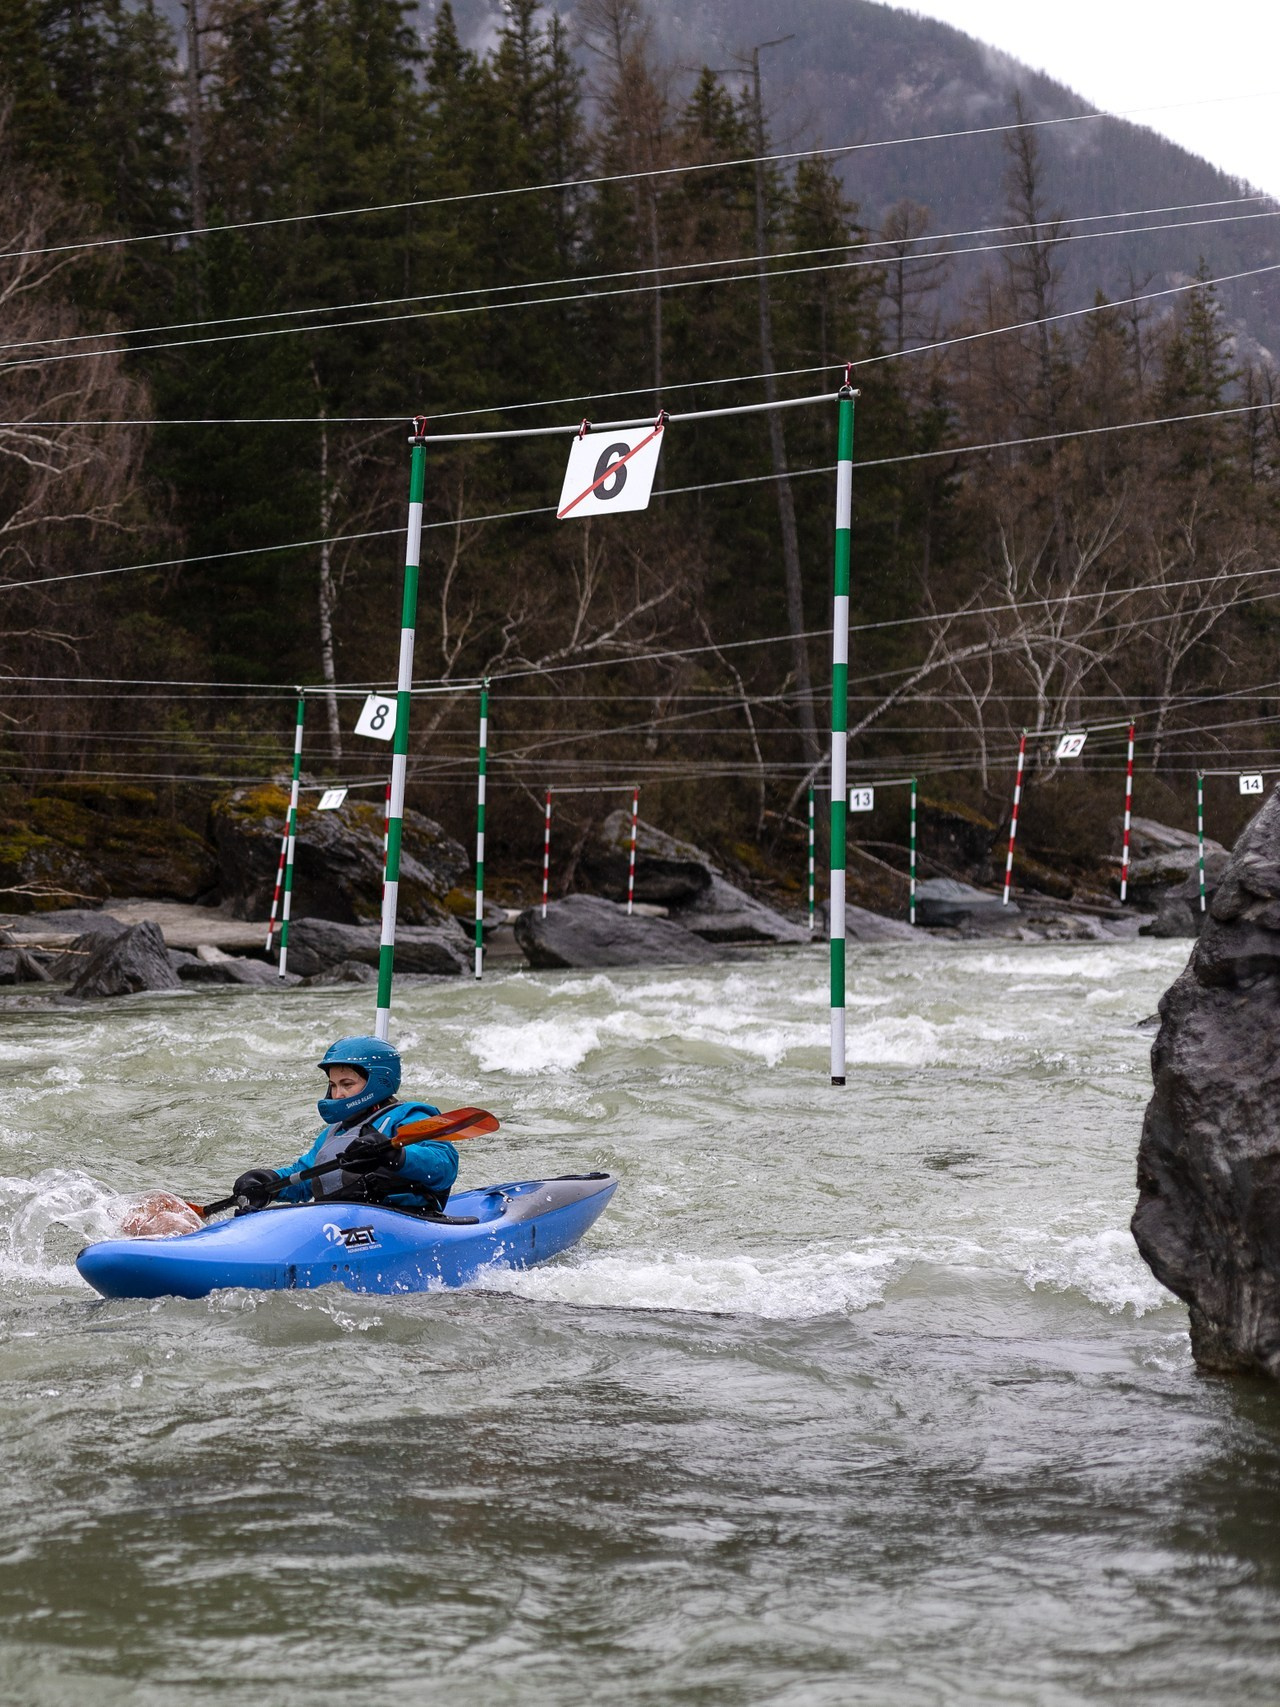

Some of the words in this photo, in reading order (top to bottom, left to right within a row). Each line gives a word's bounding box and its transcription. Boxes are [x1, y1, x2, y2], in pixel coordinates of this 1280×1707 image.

[593, 442, 630, 500] 6
[370, 704, 389, 730] 8
[1063, 739, 1081, 752] 12
[1243, 779, 1260, 790] 14
[854, 792, 870, 806] 13
[346, 1099, 361, 1109] SHRED
[361, 1093, 374, 1103] READY
[340, 1225, 377, 1247] ZET
